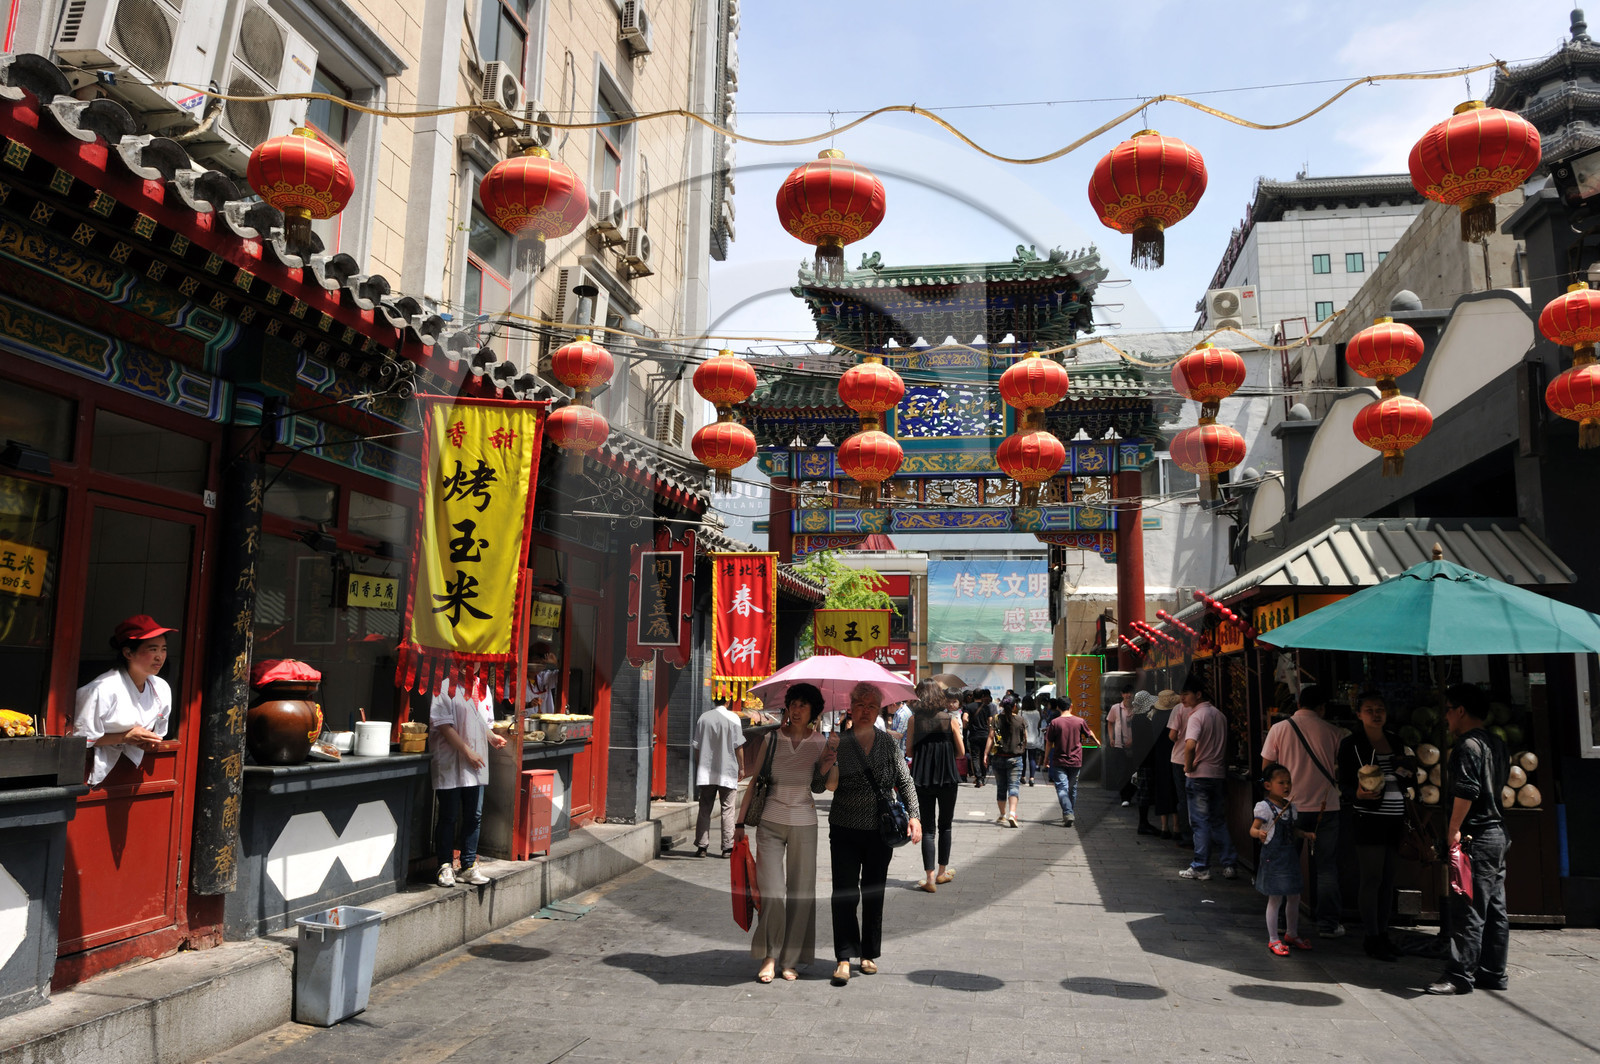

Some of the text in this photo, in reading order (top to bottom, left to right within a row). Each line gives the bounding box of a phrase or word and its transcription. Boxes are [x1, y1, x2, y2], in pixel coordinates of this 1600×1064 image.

[446, 421, 518, 450] 香甜
[432, 459, 498, 628] 烤玉米
[0, 551, 35, 575] 玉米
[722, 562, 767, 578] 老北京
[0, 575, 32, 590] 份6元
[953, 572, 1049, 599] 传承文明
[723, 583, 765, 669] 春饼
[823, 620, 881, 643] 蝎王子
[1002, 607, 1052, 633] 感受
[887, 648, 906, 656] KFC
[940, 646, 1053, 661] 北京旅游工
